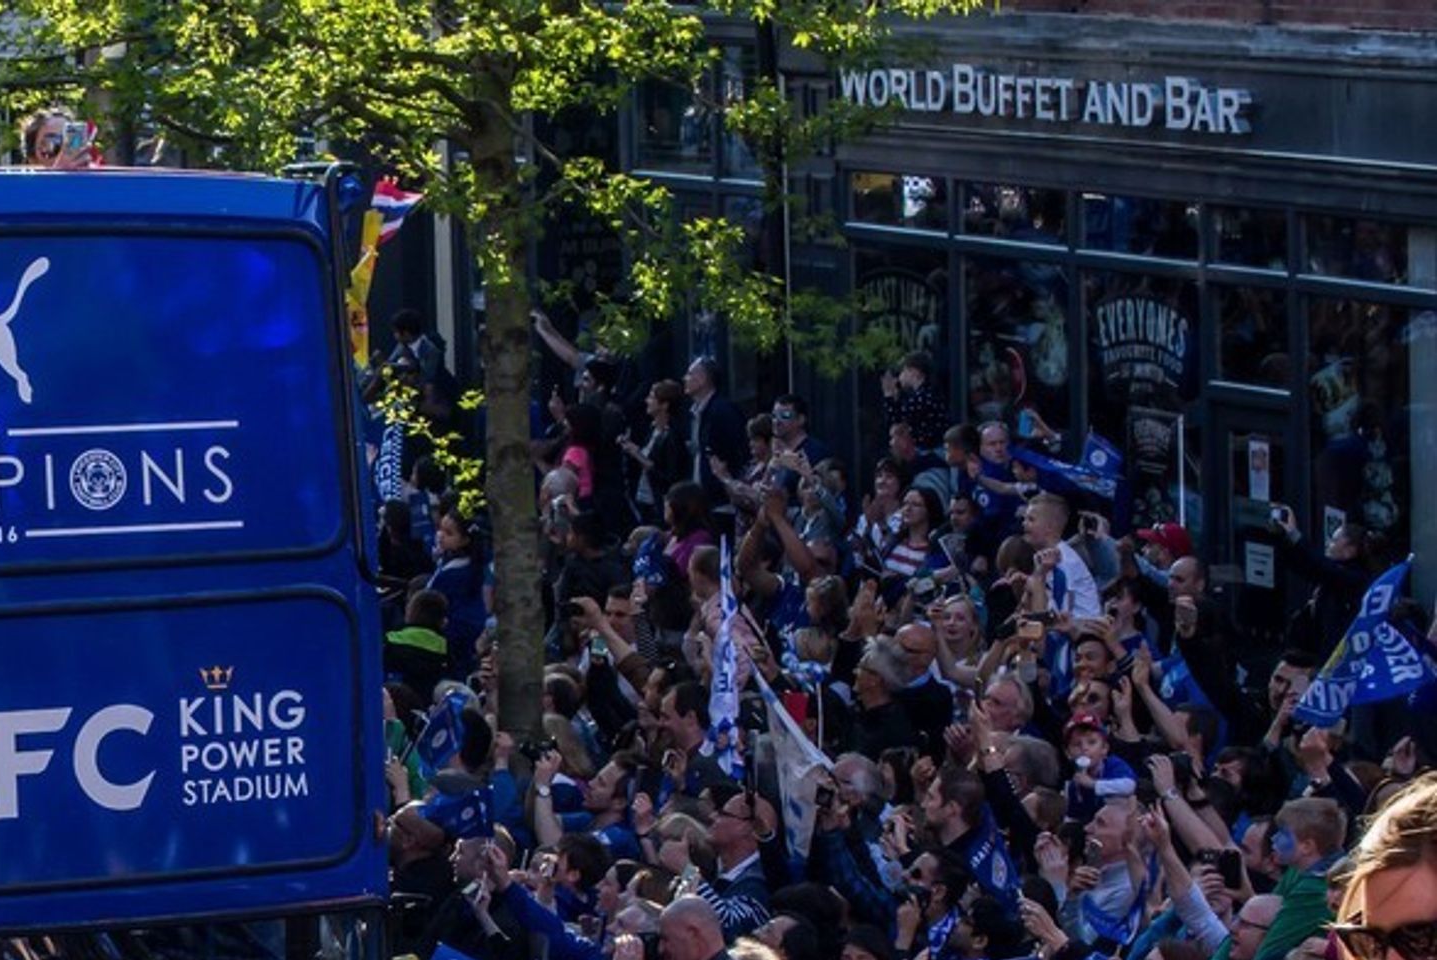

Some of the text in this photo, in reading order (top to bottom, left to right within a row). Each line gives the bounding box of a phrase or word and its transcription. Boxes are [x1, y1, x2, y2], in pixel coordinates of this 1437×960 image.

[839, 63, 1241, 134] WORLD BUFFET AND BAR
[179, 690, 306, 737] KING
[181, 736, 306, 773] POWER
[183, 771, 309, 806] STADIUM
